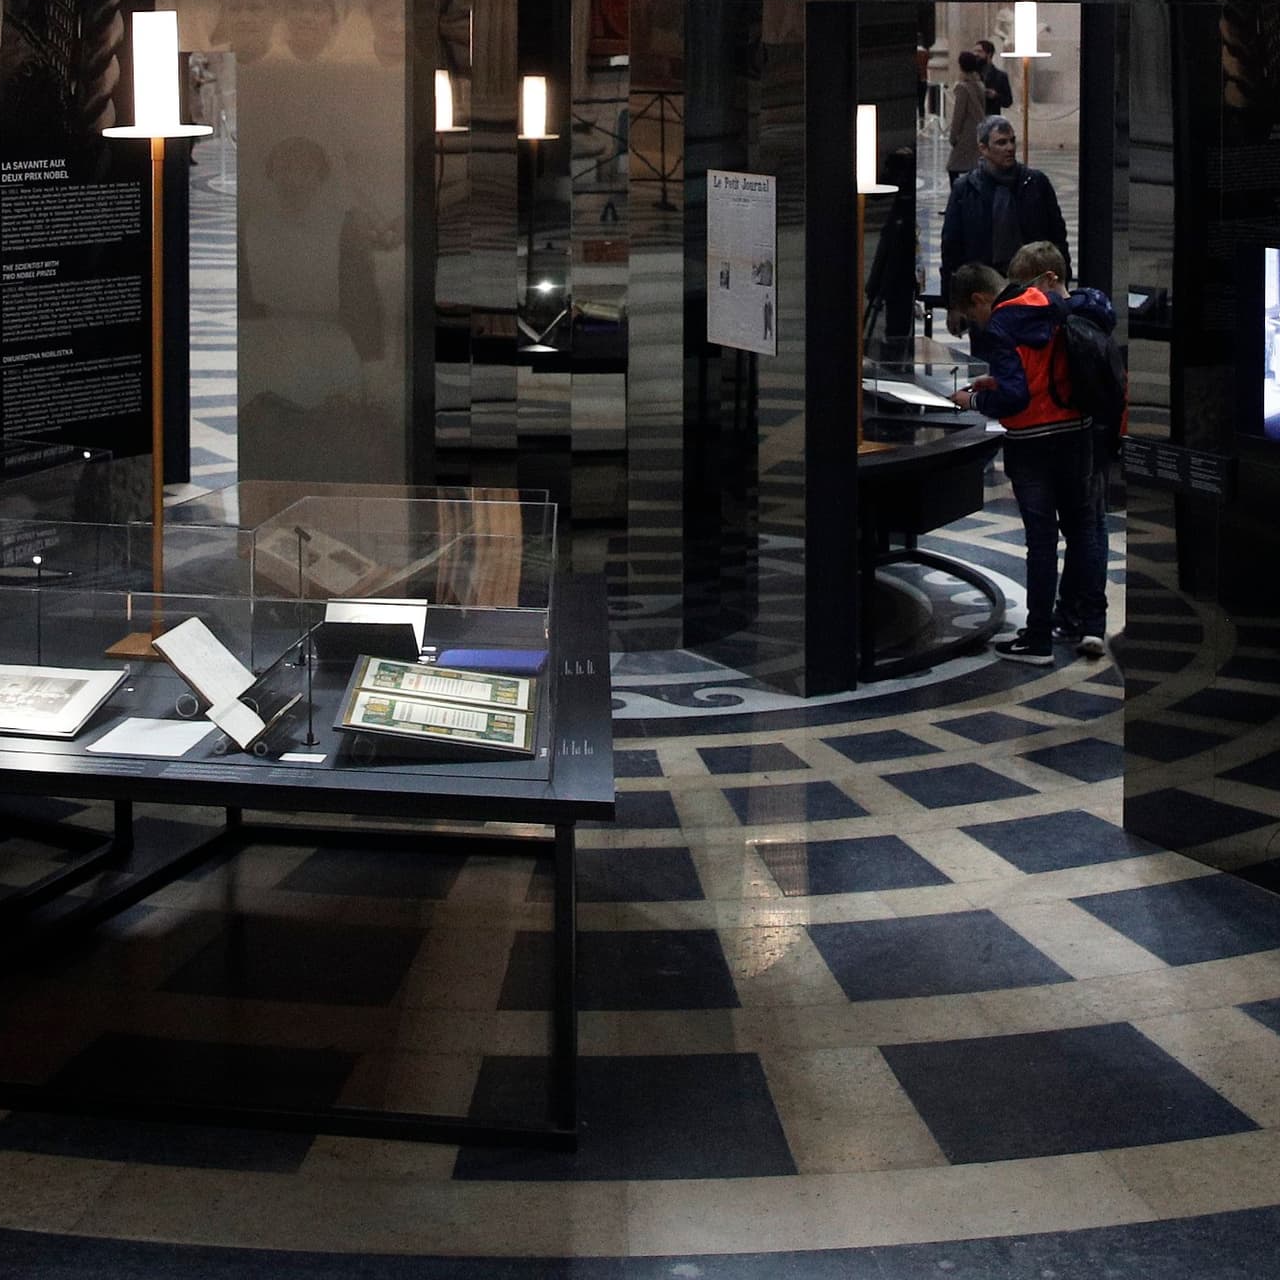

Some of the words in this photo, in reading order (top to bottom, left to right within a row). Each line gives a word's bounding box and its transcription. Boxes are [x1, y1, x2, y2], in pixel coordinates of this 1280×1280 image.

[2, 162, 12, 171] LA
[13, 160, 49, 170] SAVANTE
[50, 159, 66, 168] AUX
[2, 173, 23, 183] DEUX
[24, 172, 43, 181] PRIX
[43, 170, 69, 180] NOBEL
